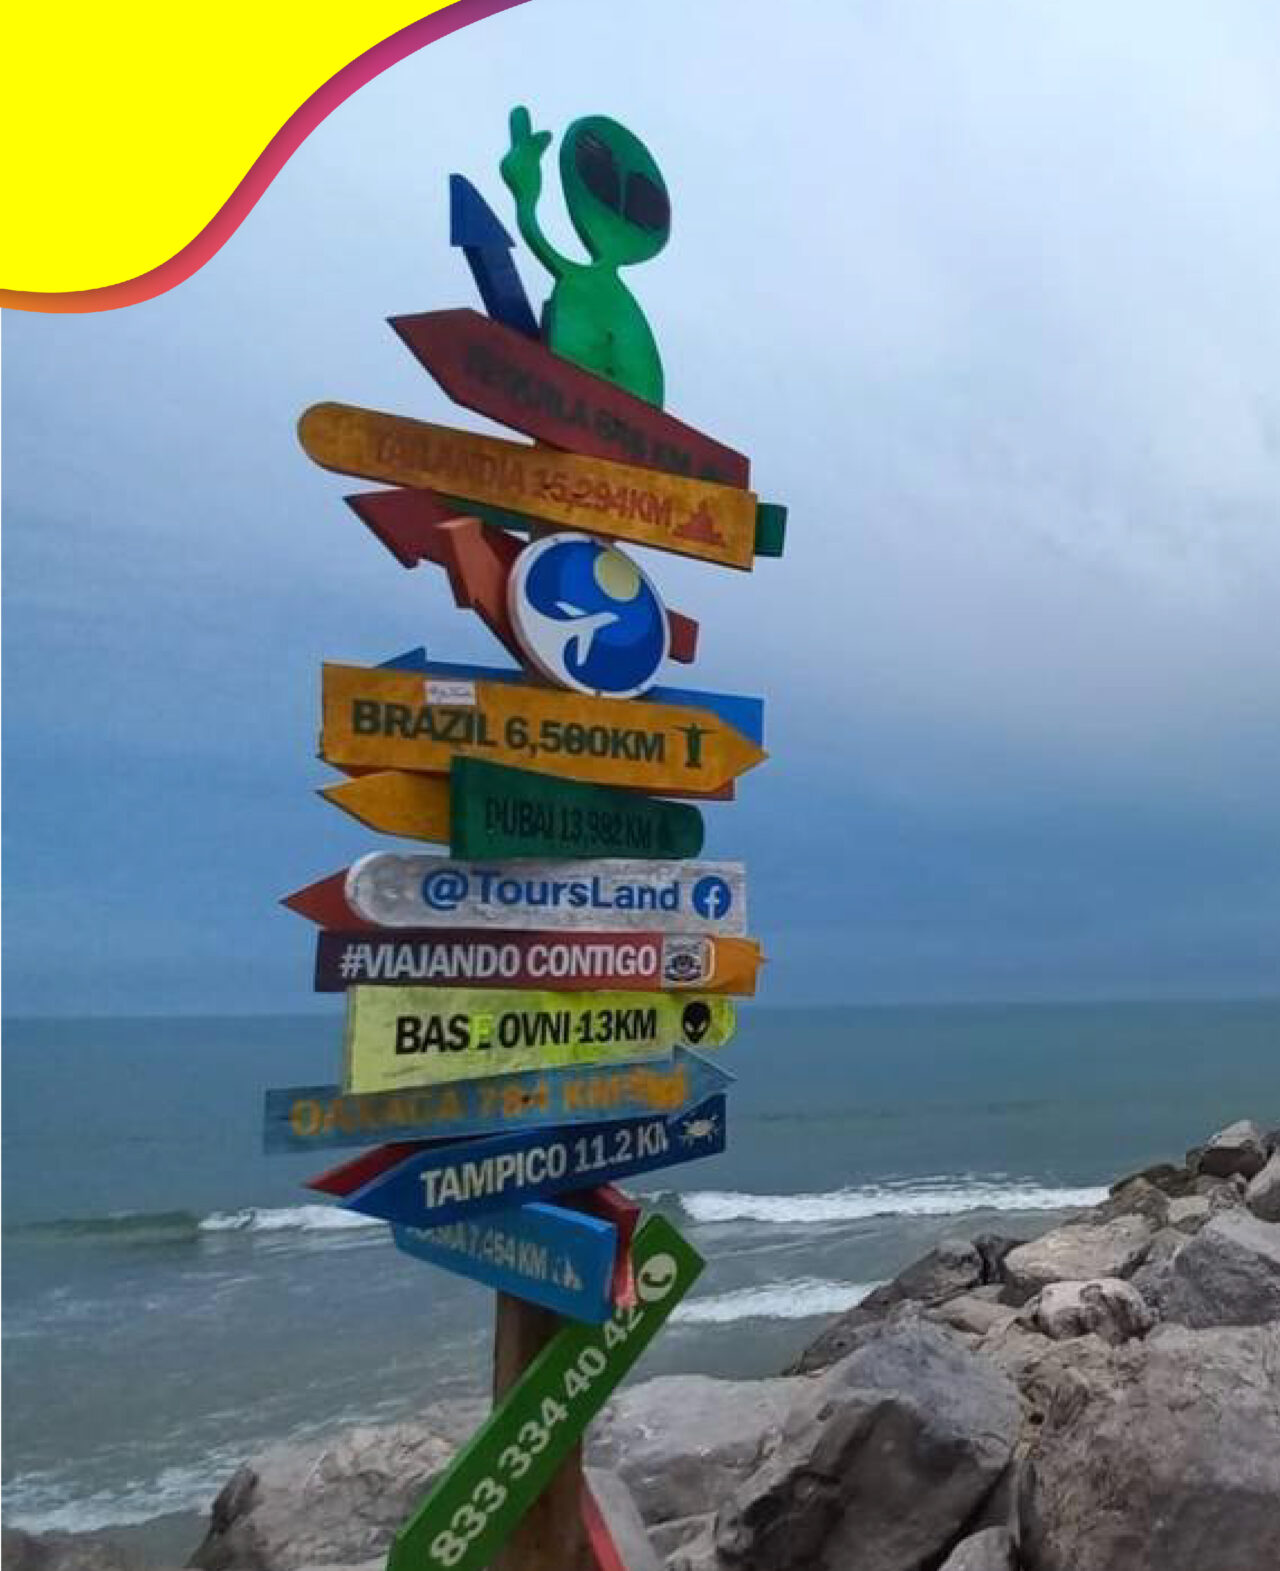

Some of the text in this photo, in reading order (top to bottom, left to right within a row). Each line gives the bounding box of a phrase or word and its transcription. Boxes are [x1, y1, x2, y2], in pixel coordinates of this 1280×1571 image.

[352, 699, 498, 748] BRAZIL
[485, 797, 555, 842] DUBAI
[420, 868, 681, 911] @ToursLand
[340, 942, 657, 979] #VIAJANDO CONTIGO
[497, 1011, 570, 1048] OVNI
[420, 1144, 567, 1209] TAMPICO
[574, 1128, 633, 1173] 11.2
[429, 1476, 508, 1567] 833
[498, 1397, 570, 1479] 334
[563, 1348, 608, 1399] 40
